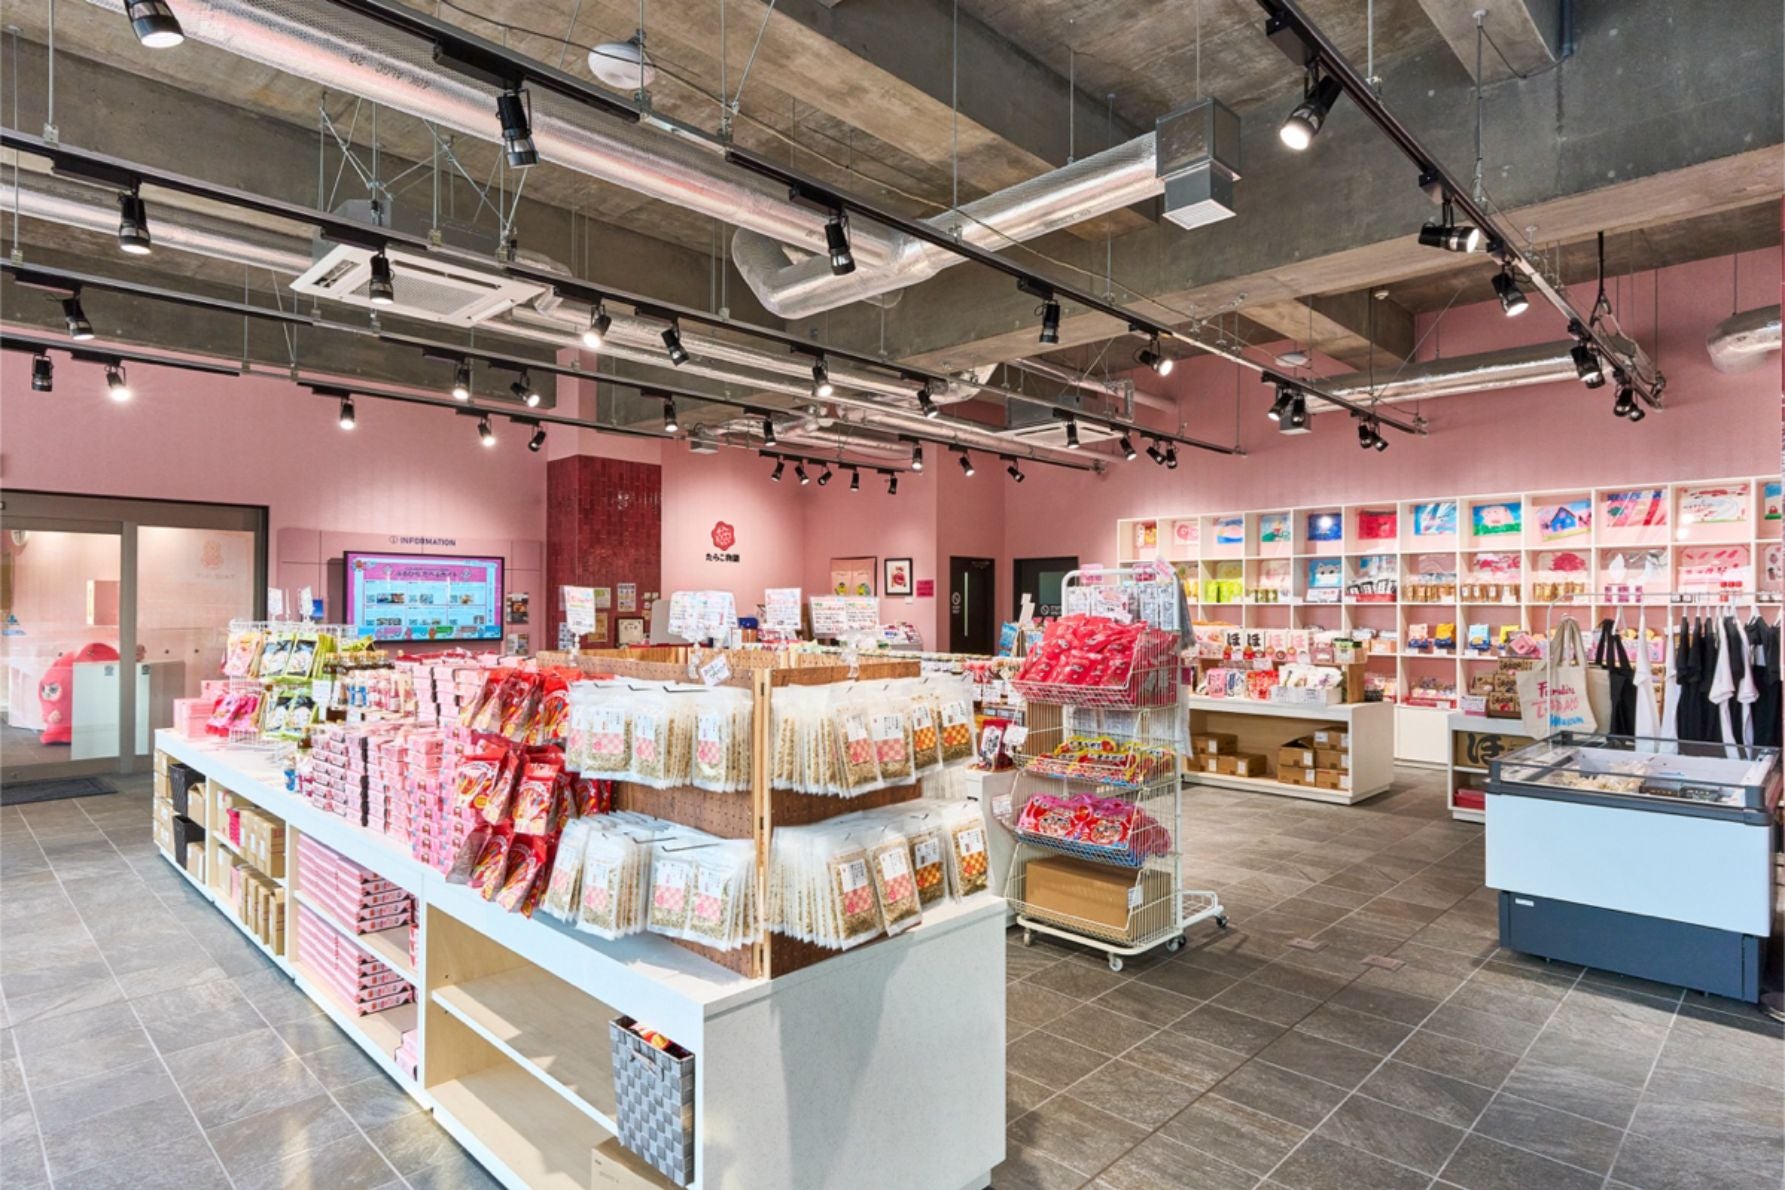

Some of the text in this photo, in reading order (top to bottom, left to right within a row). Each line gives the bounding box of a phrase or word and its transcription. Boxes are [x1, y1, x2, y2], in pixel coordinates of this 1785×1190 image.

[401, 538, 456, 546] INFORMATION
[1227, 633, 1240, 646] ほ
[1247, 633, 1260, 646] ほ
[1468, 733, 1505, 764] ほ
